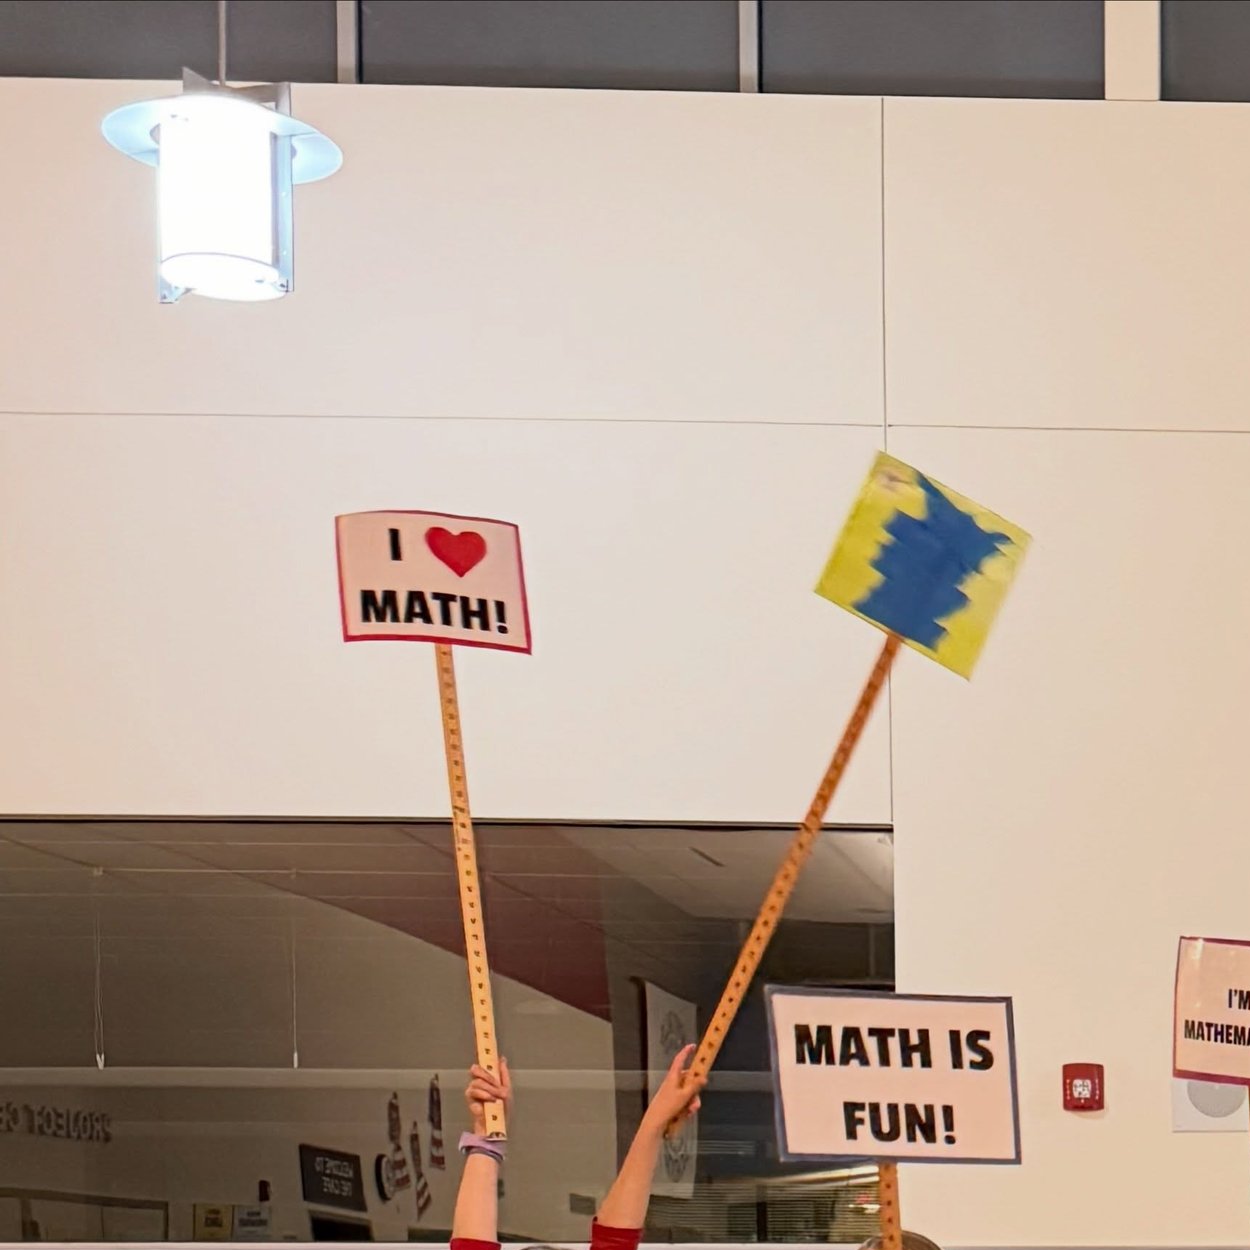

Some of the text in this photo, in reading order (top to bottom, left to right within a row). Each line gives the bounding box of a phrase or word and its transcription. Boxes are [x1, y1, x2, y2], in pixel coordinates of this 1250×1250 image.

[388, 527, 403, 561] I
[360, 589, 509, 634] MATH!
[794, 1023, 995, 1071] MATH IS
[842, 1101, 957, 1145] FUN!
